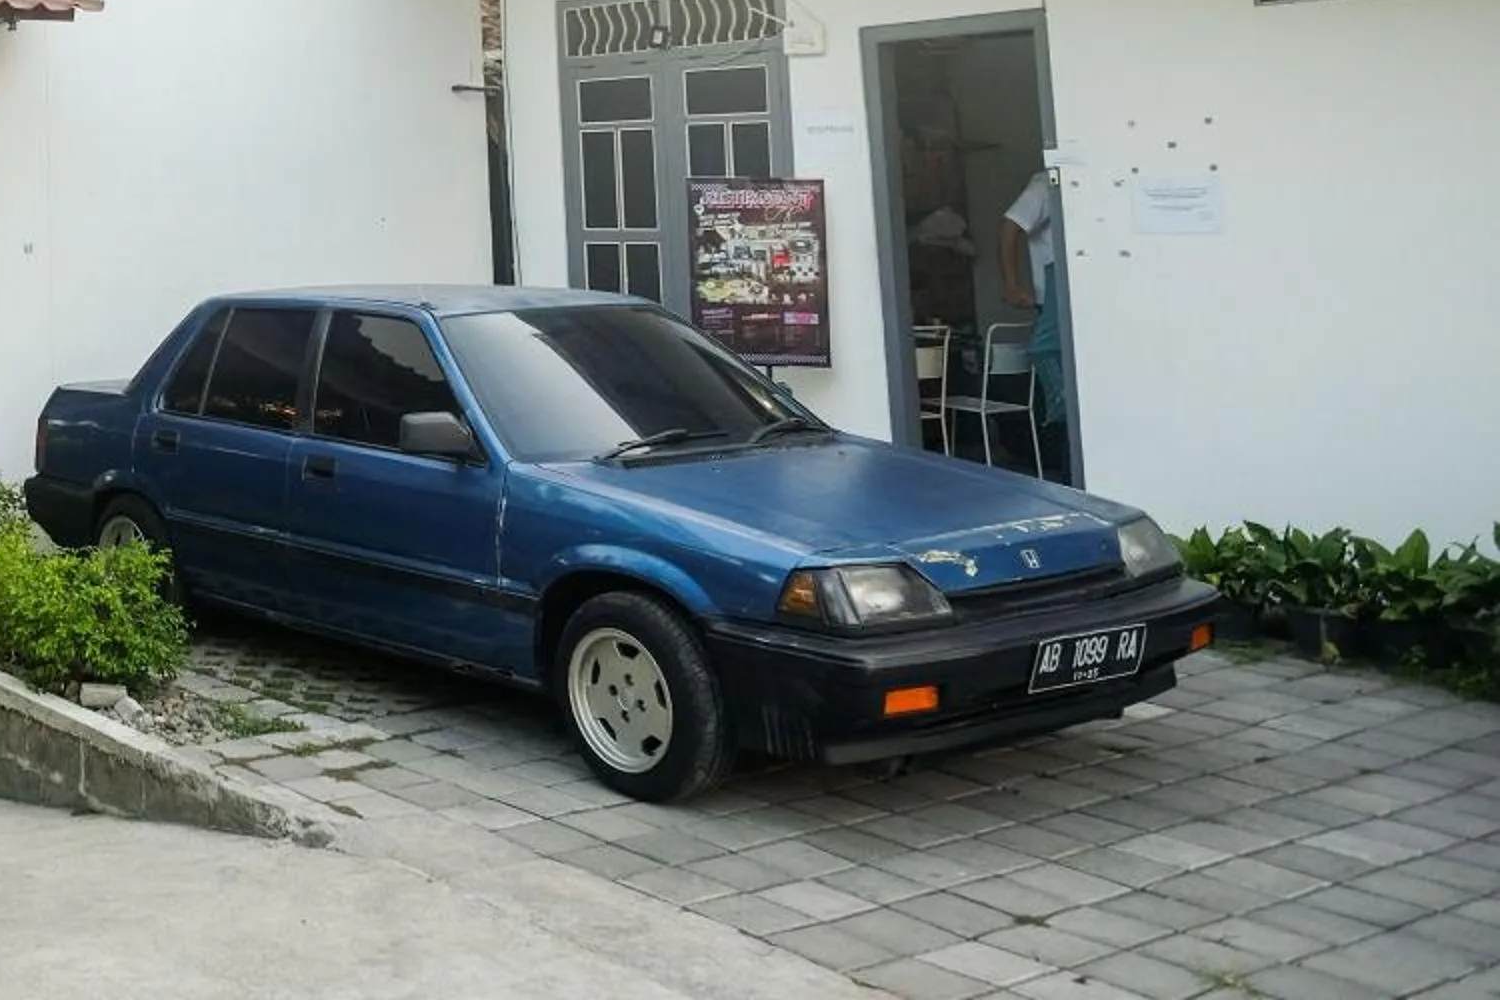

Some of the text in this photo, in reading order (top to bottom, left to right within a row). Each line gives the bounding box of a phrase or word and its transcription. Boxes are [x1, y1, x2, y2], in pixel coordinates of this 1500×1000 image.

[1038, 630, 1138, 674] AB 1099 RA
